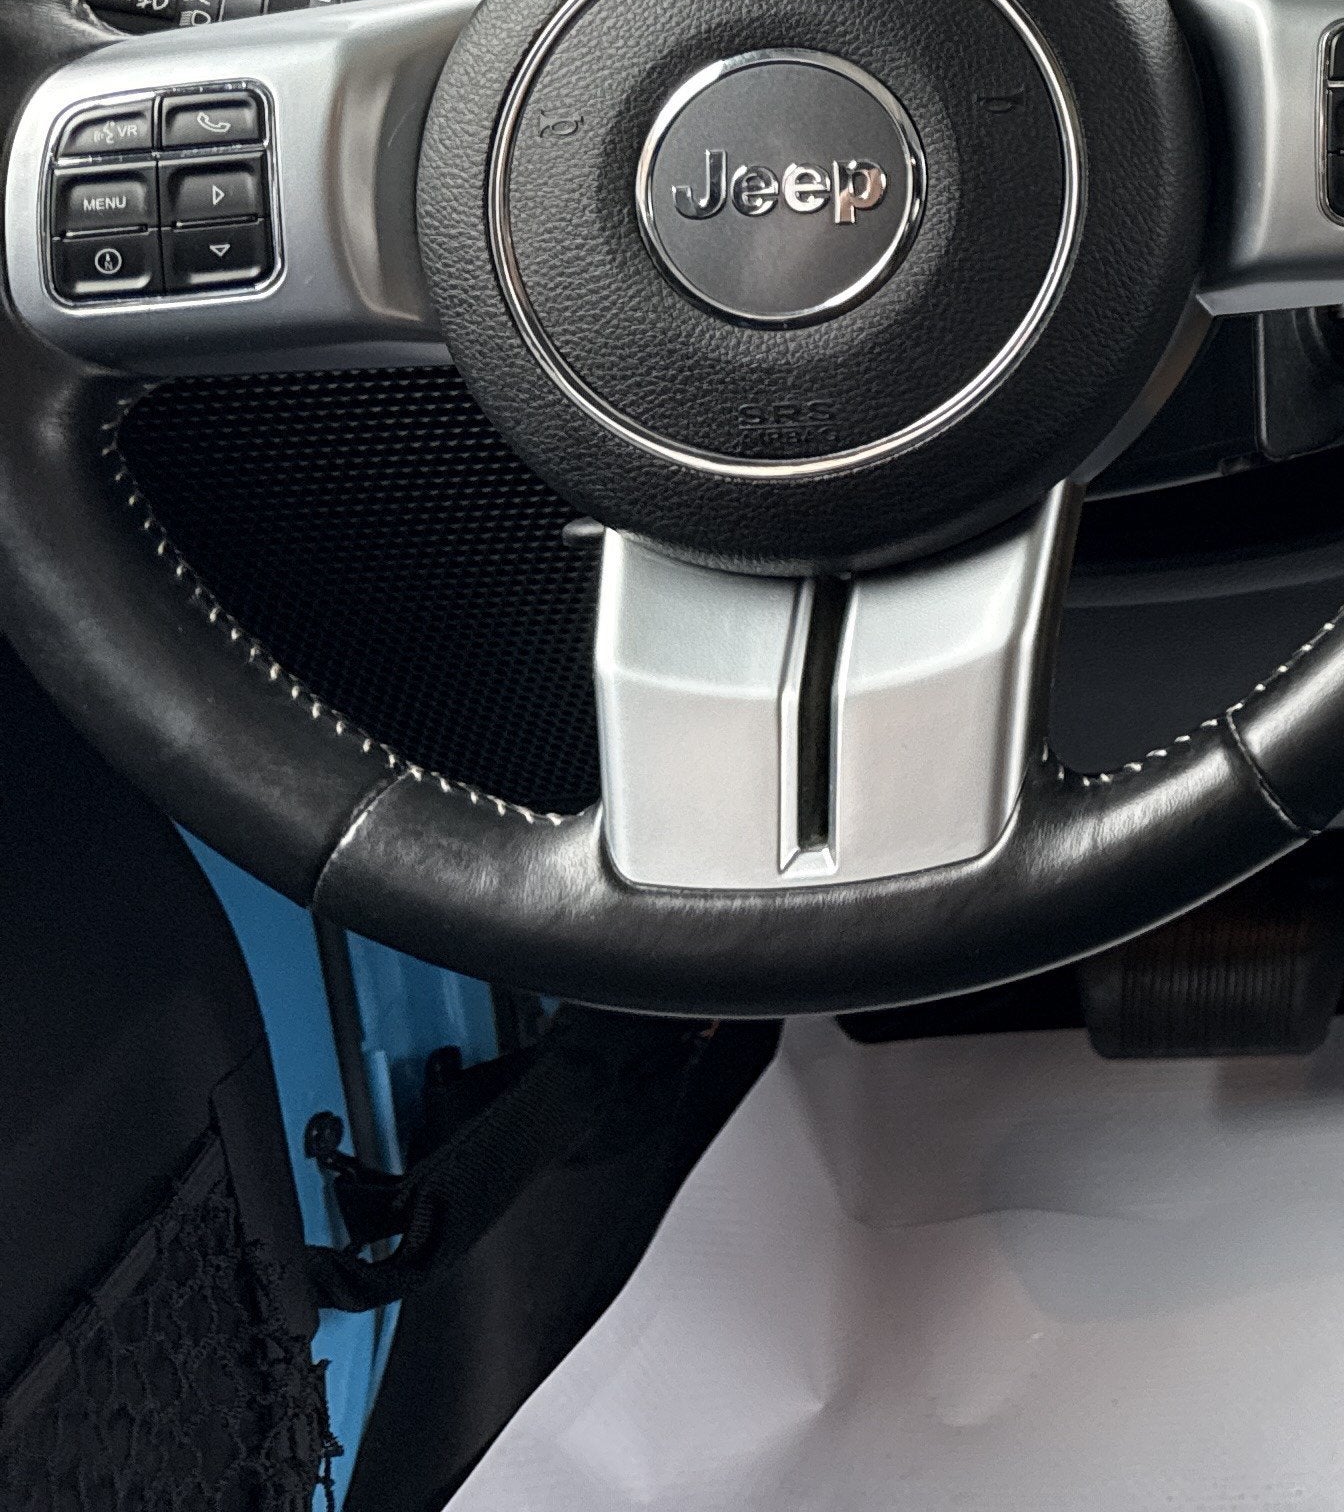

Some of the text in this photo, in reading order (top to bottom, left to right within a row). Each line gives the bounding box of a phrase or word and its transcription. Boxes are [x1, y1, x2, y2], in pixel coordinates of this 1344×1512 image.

[117, 124, 139, 139] VR
[670, 149, 888, 226] Jeep
[83, 195, 127, 212] MENU
